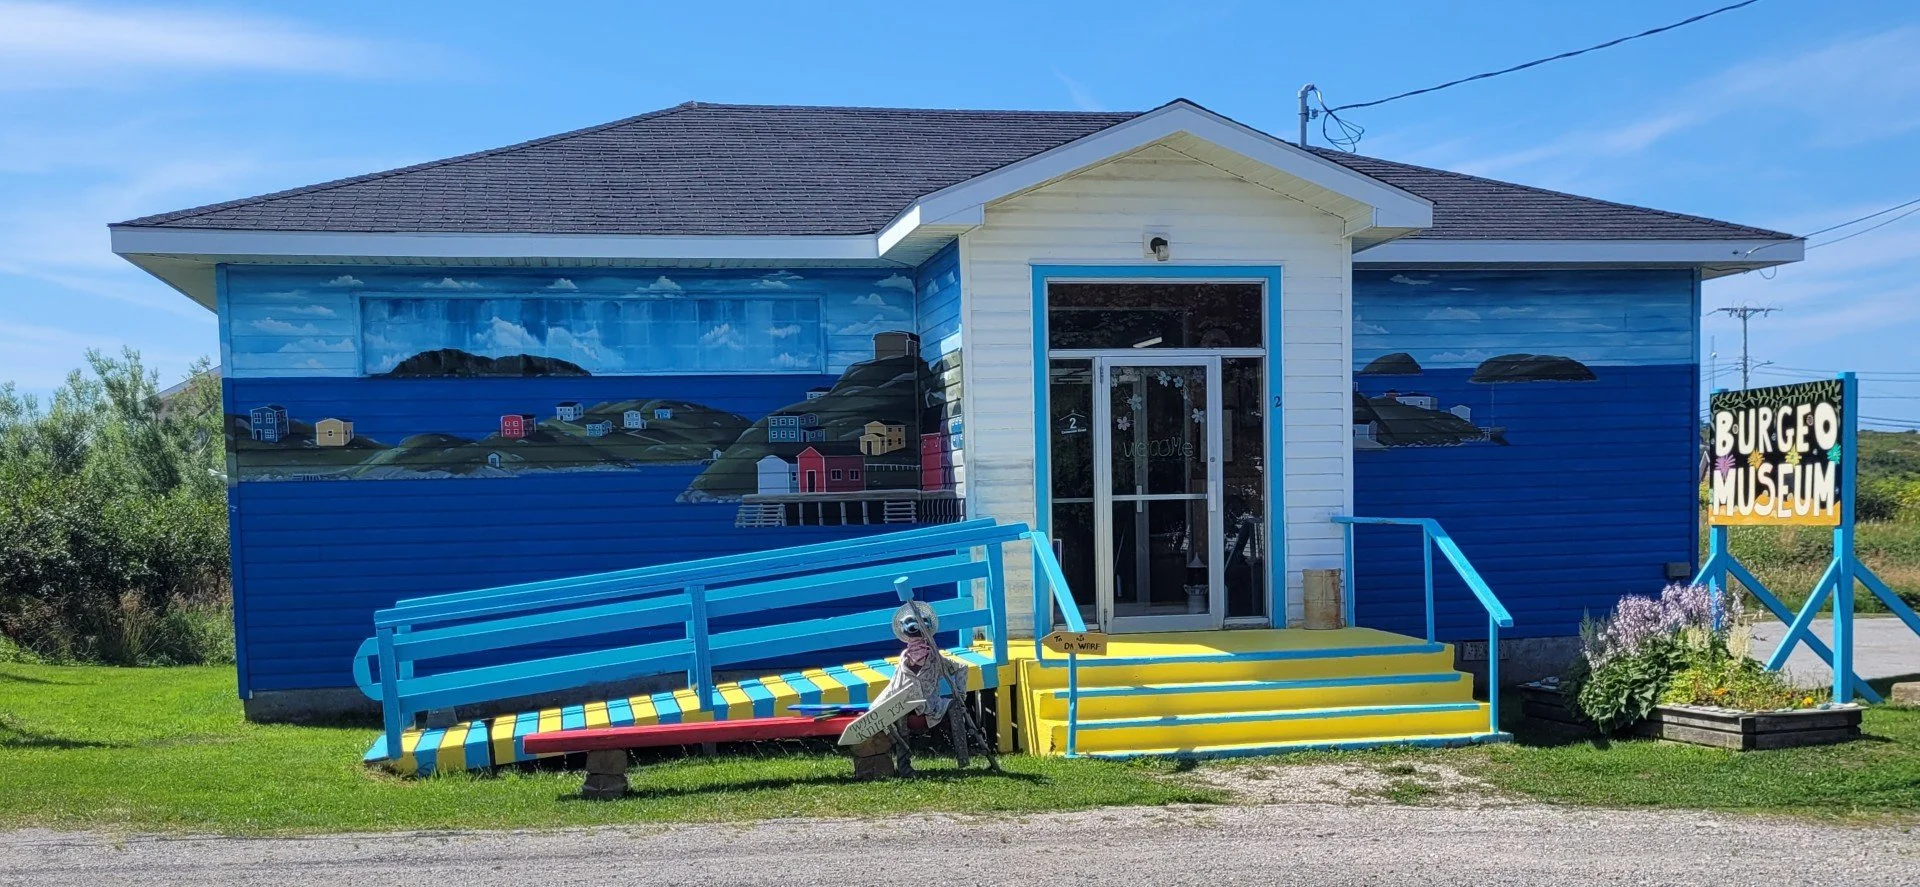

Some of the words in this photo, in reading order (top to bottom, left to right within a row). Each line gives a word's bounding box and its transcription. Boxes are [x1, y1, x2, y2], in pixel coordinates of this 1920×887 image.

[1273, 395, 1282, 409] 2
[1069, 417, 1077, 429] 2
[1715, 402, 1838, 457] BURGEO
[1713, 460, 1836, 518] MUSEUM
[849, 711, 879, 733] WHO
